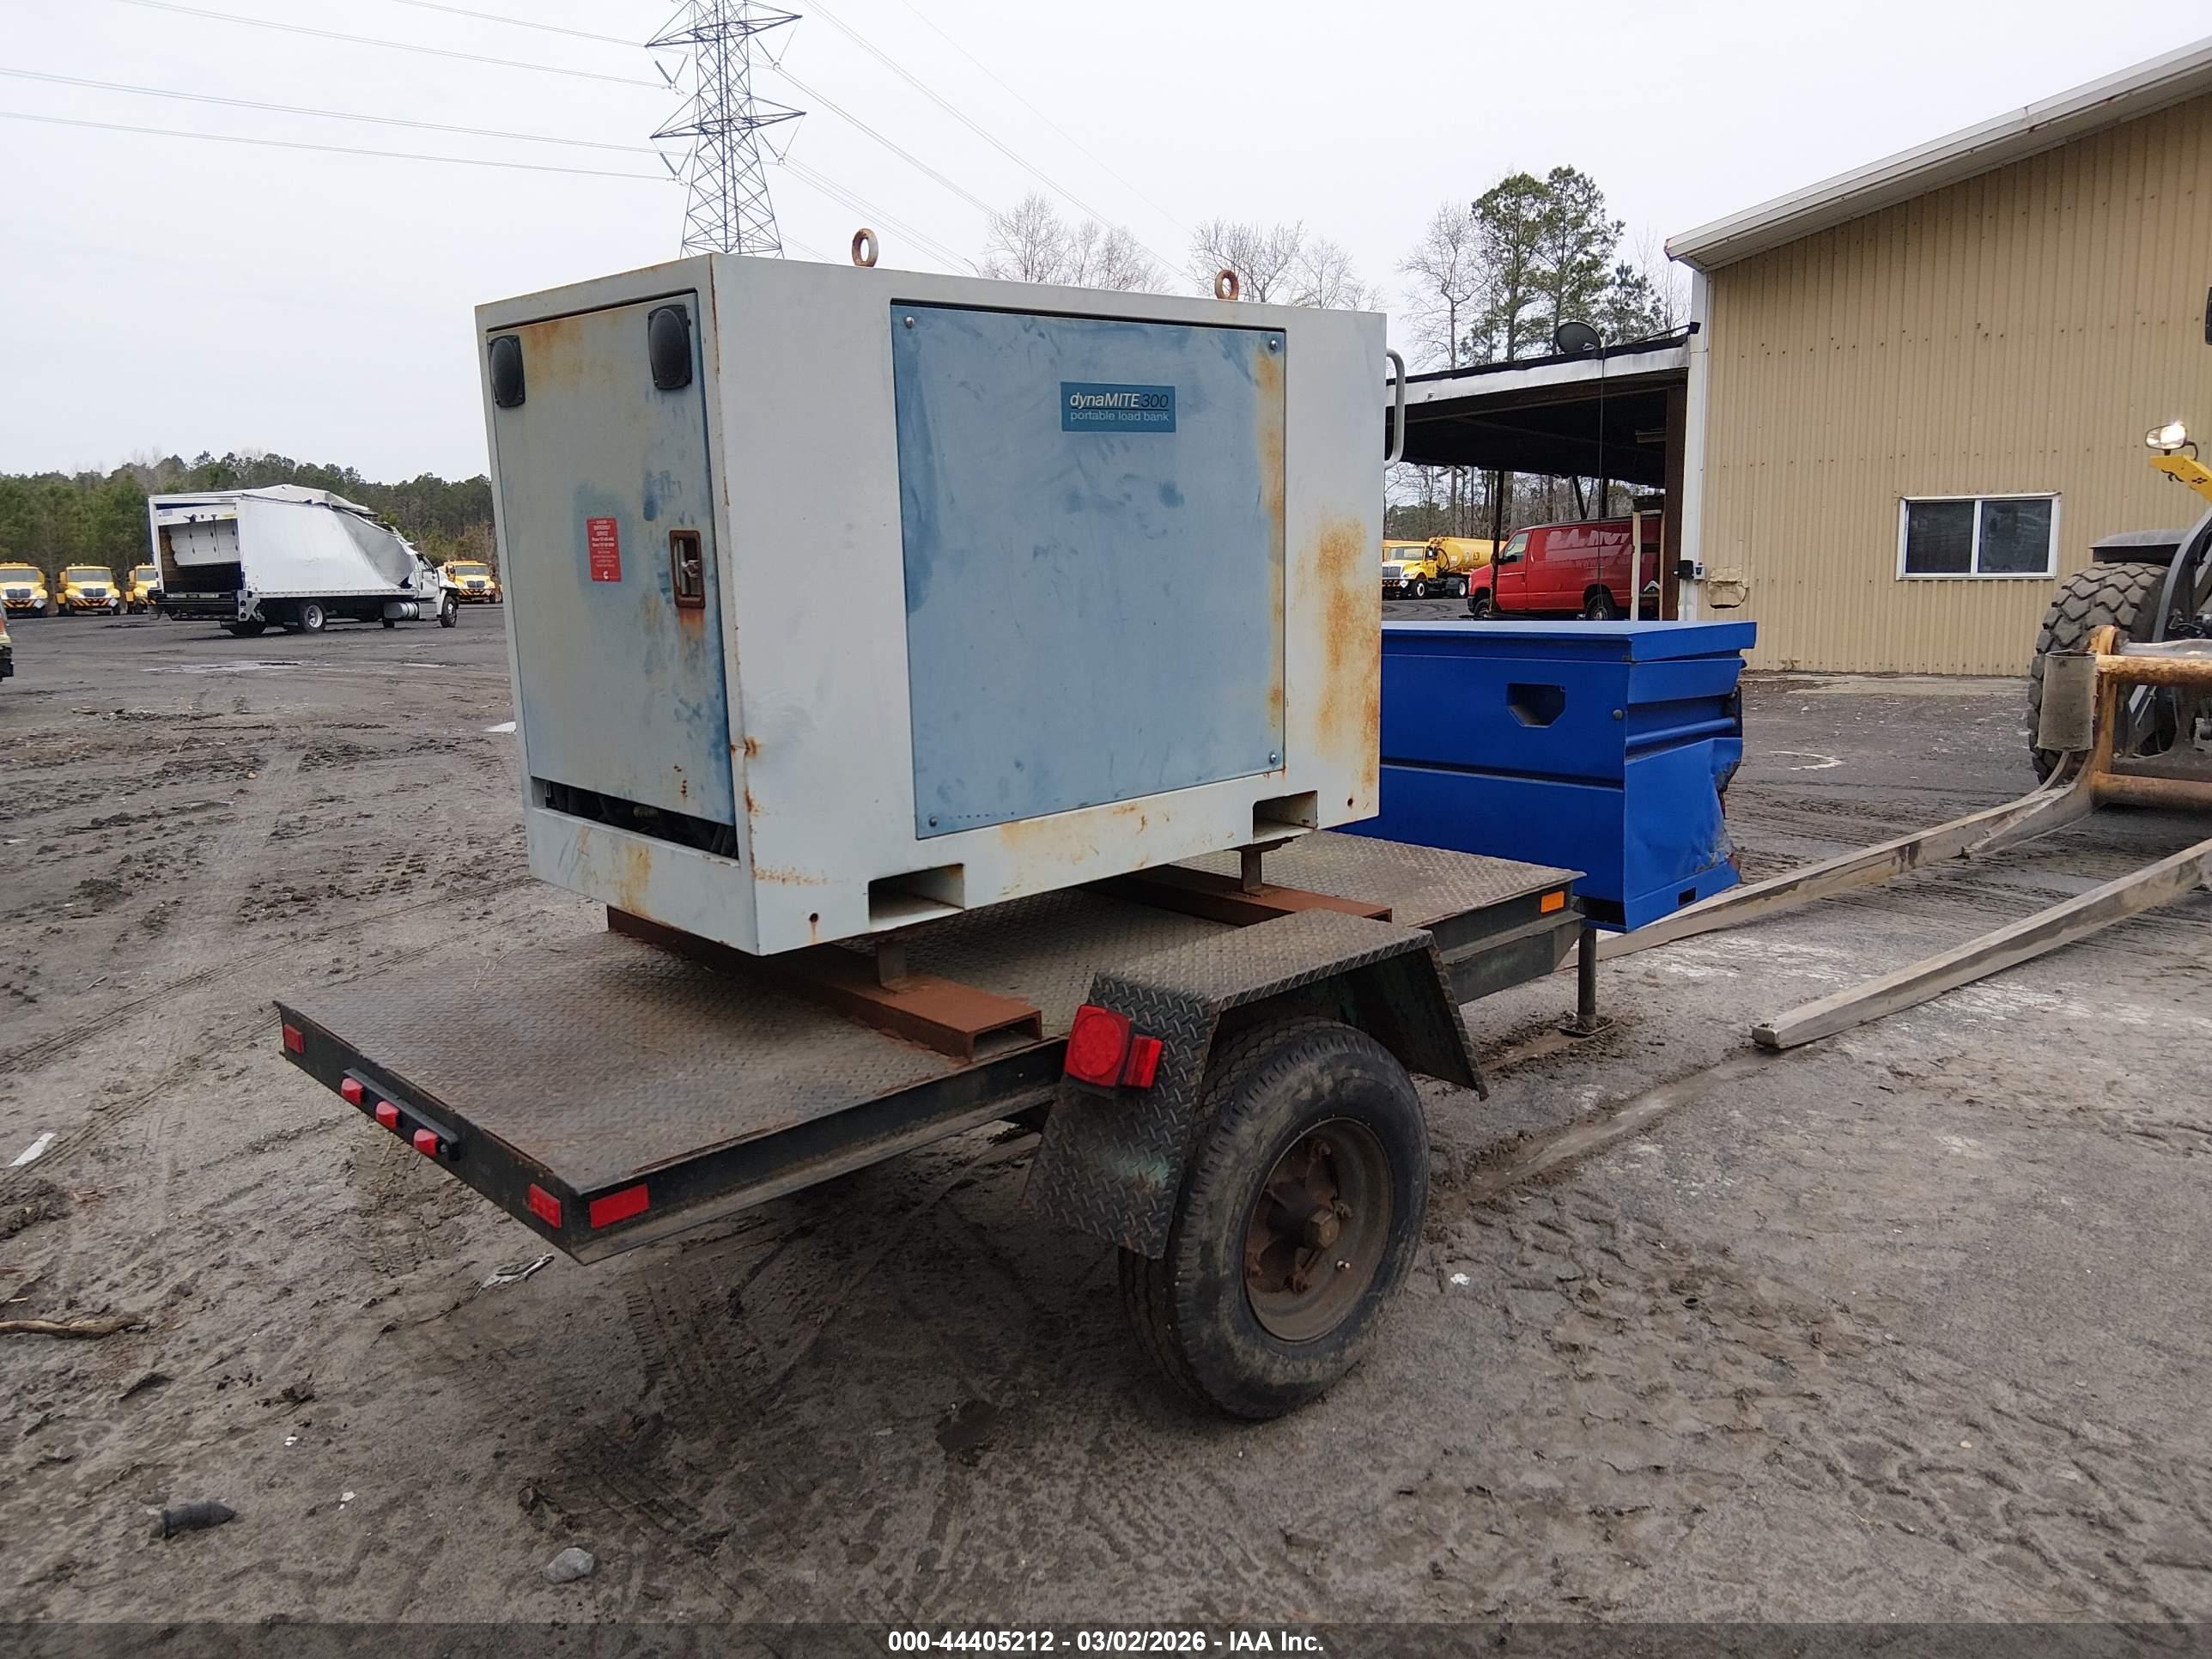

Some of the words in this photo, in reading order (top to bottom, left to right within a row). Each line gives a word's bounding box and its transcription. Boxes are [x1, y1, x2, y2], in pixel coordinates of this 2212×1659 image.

[1070, 392, 1140, 409] dynaMITE
[1140, 394, 1168, 408] 300
[1070, 411, 1115, 422] portable
[1118, 411, 1140, 421] load
[1143, 412, 1169, 422] bank
